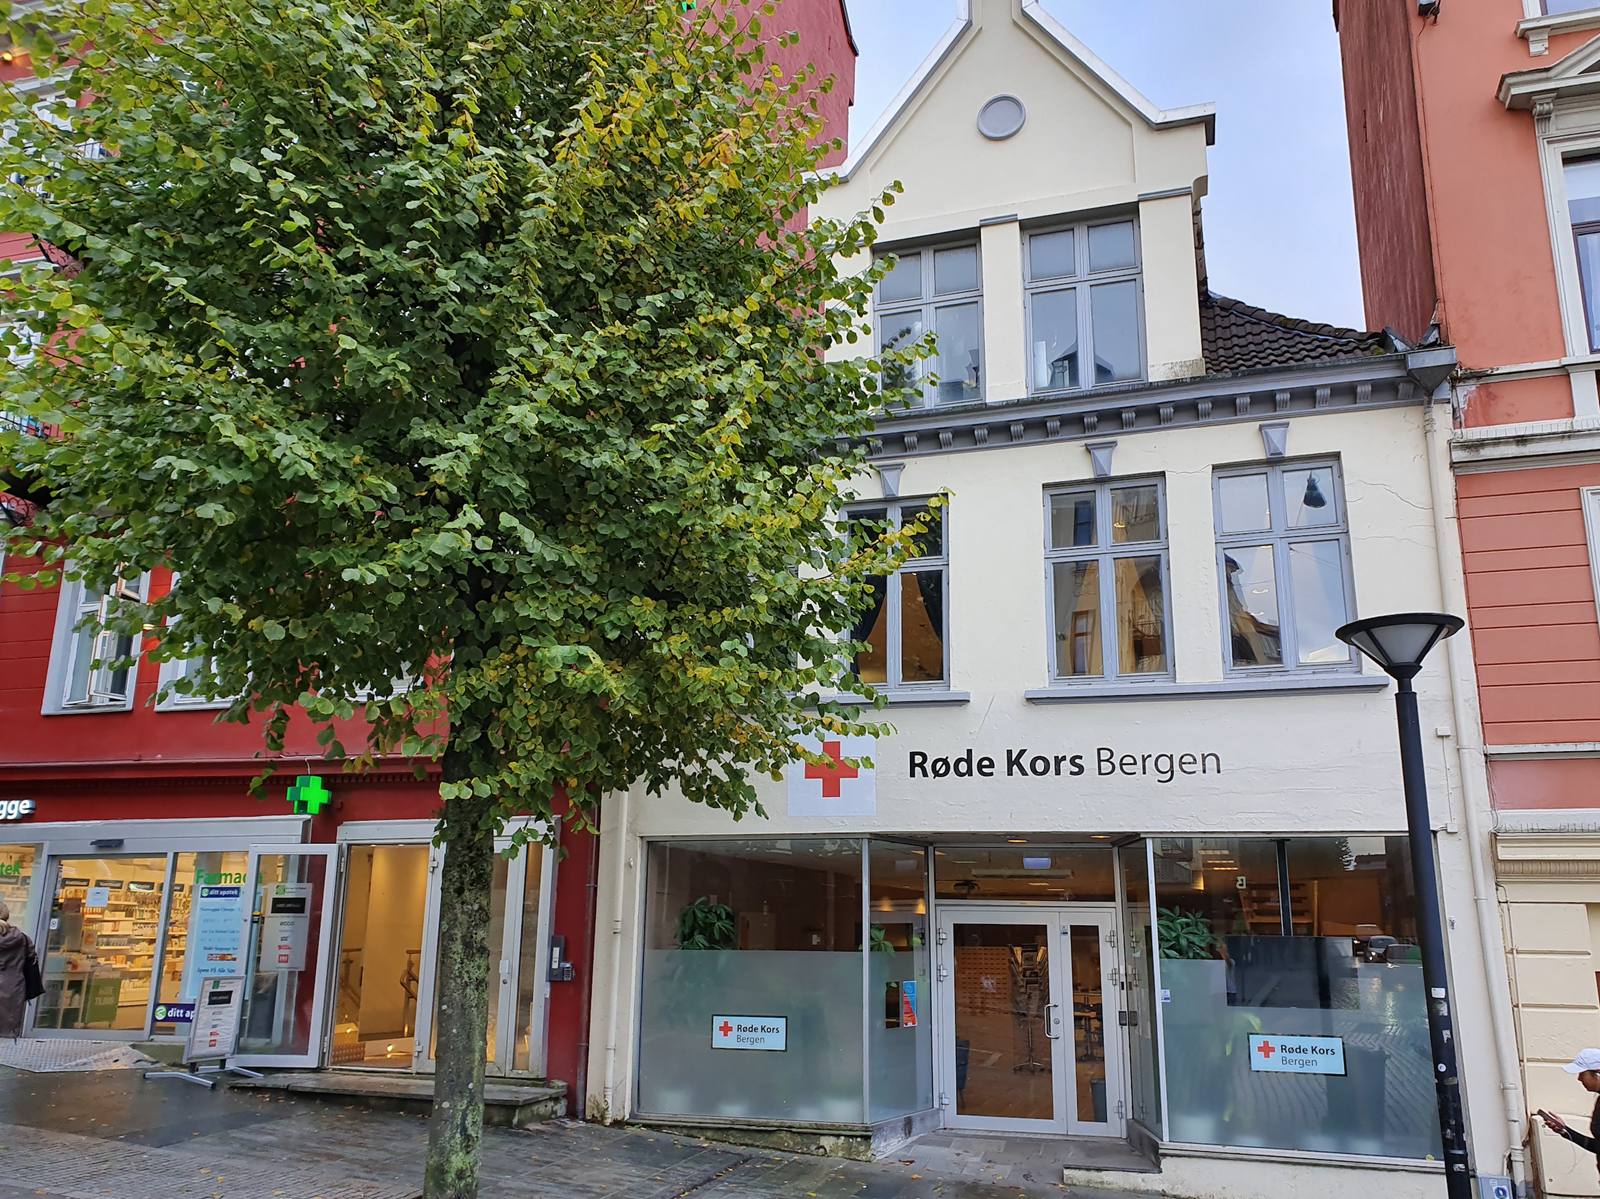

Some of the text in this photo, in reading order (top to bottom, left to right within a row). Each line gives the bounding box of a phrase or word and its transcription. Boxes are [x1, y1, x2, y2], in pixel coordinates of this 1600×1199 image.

[909, 747, 1221, 783] Røde Kors Bergen
[167, 1007, 184, 1018] ditt
[736, 1024, 780, 1034] Røde Kors
[736, 1034, 765, 1045] Bergen
[1280, 1044, 1336, 1055] Røde Kors
[1281, 1056, 1318, 1068] Bergen
